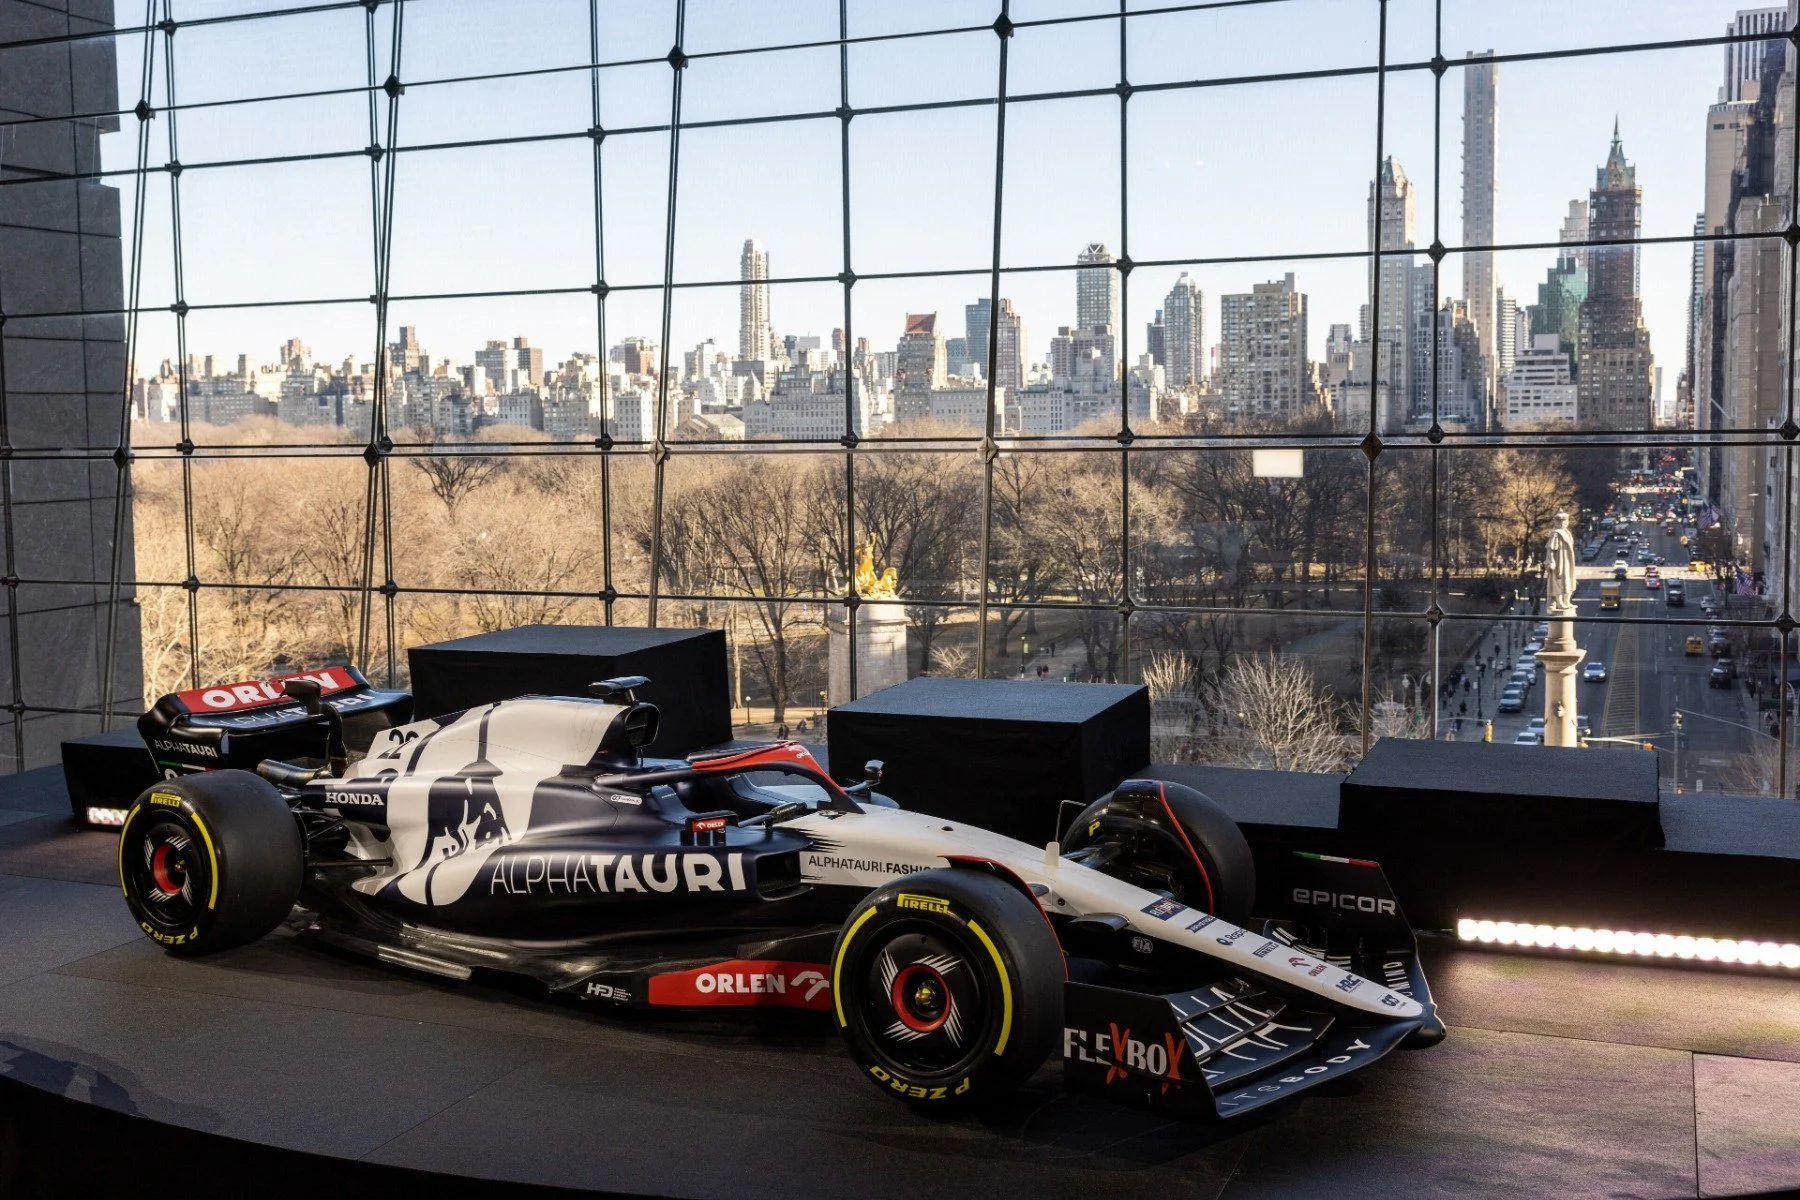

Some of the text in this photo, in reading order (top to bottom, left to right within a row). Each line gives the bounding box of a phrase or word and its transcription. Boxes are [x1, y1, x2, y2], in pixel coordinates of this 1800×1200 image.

[202, 672, 339, 708] ORLN
[154, 740, 219, 757] ALPHATAURI
[150, 792, 182, 808] PIRELLI
[325, 792, 385, 806] HONDA
[491, 852, 747, 895] ALPHATAURI
[897, 893, 950, 914] PIRELLI
[141, 922, 199, 945] P ZERO
[1132, 936, 1154, 954] FIA
[1252, 941, 1280, 958] PIRELLI
[695, 973, 786, 993] ORLEN
[869, 1065, 970, 1099] P ZERO
